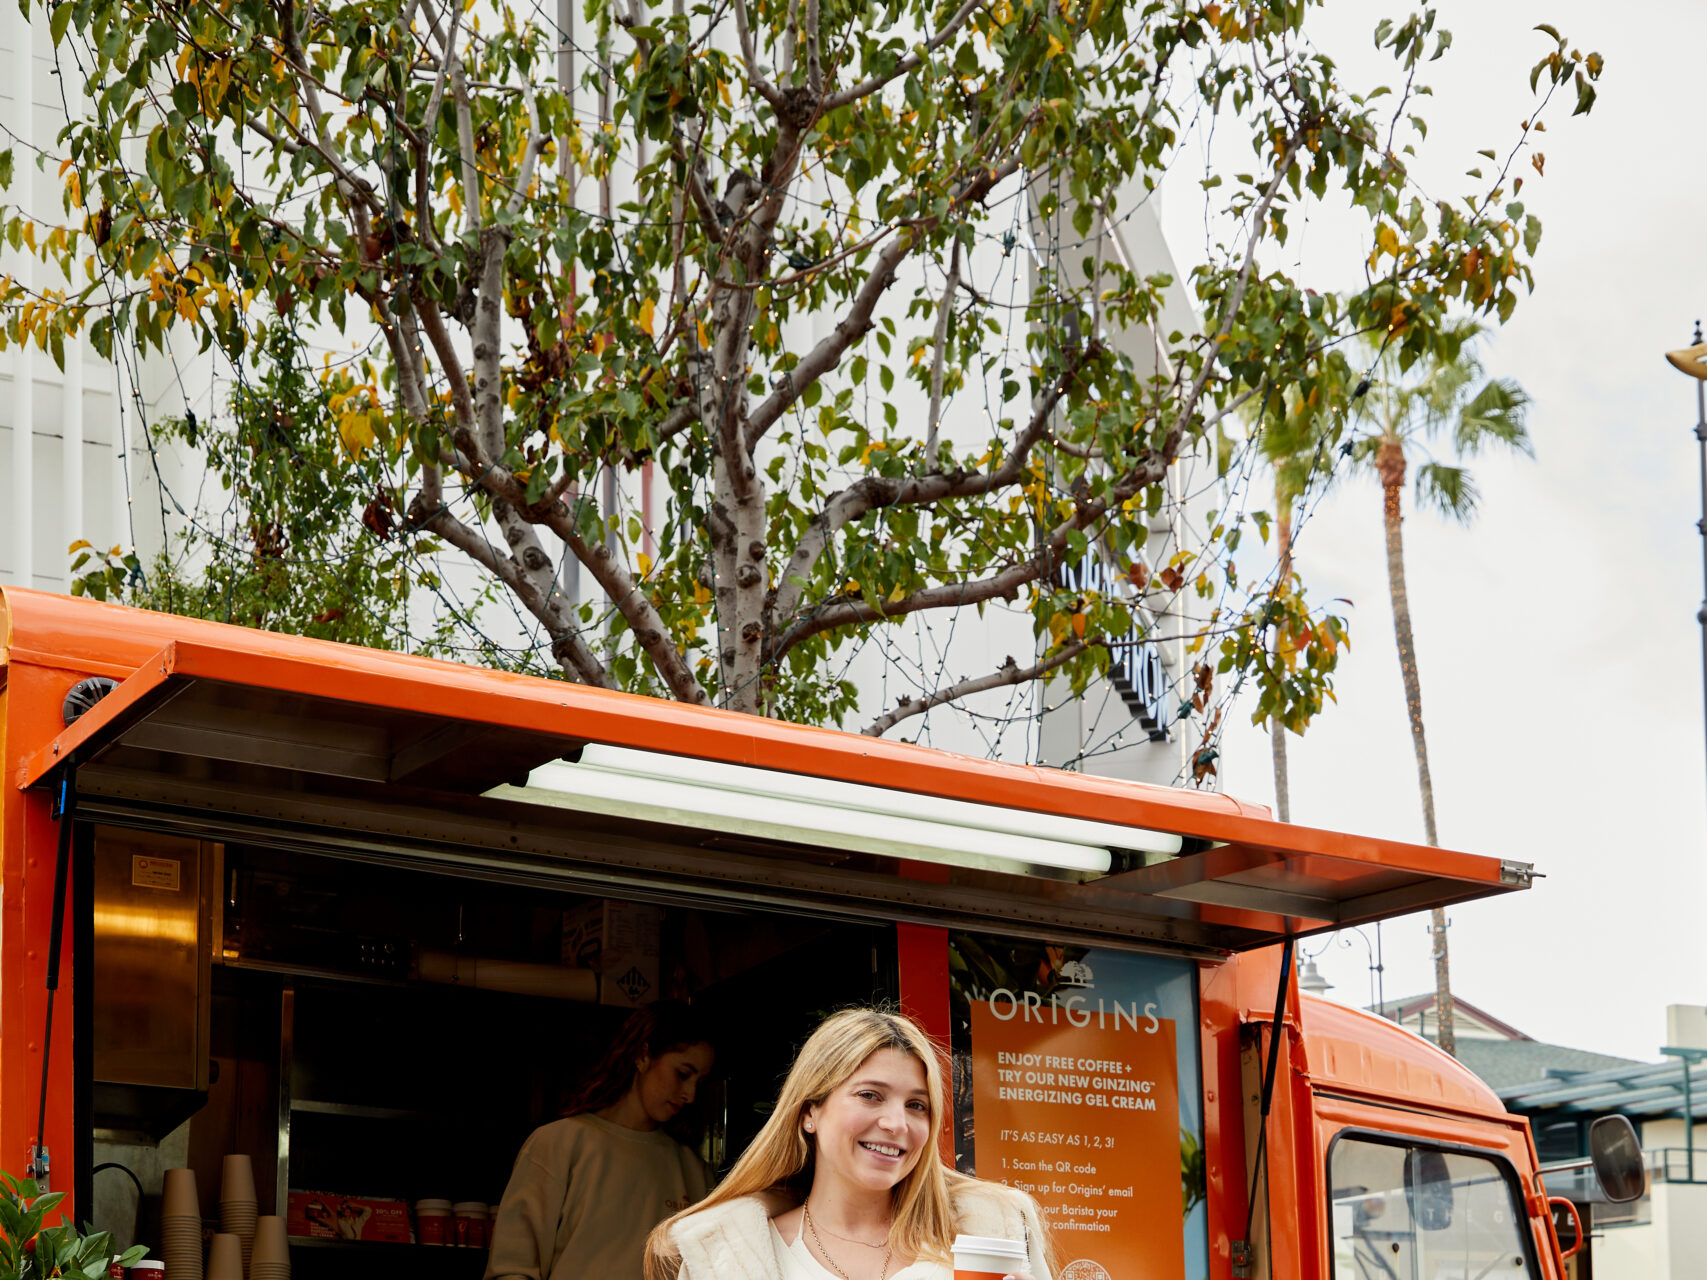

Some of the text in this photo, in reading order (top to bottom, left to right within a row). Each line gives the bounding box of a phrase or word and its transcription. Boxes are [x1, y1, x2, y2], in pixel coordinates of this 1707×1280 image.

[989, 988, 1159, 1034] ORIGINS
[998, 1051, 1132, 1074] ENJOY FREE COFFEE +
[997, 1069, 1022, 1083] TRY
[1025, 1071, 1055, 1086] OUR
[1058, 1073, 1090, 1088] NEW
[999, 1087, 1156, 1111] ENERGIZING GEL CREAM
[1000, 1129, 1115, 1148] IT'S AS EASY AS 1, 2, 3!
[1001, 1158, 1097, 1174] 1. Scan the QR code
[1014, 1180, 1035, 1193] Sign
[1038, 1184, 1050, 1195] up
[1052, 1181, 1066, 1193] for
[1068, 1183, 1106, 1198] Origins'
[1108, 1186, 1133, 1197] email
[1043, 1204, 1118, 1219] our Barista your
[1052, 1218, 1110, 1232] confirmation
